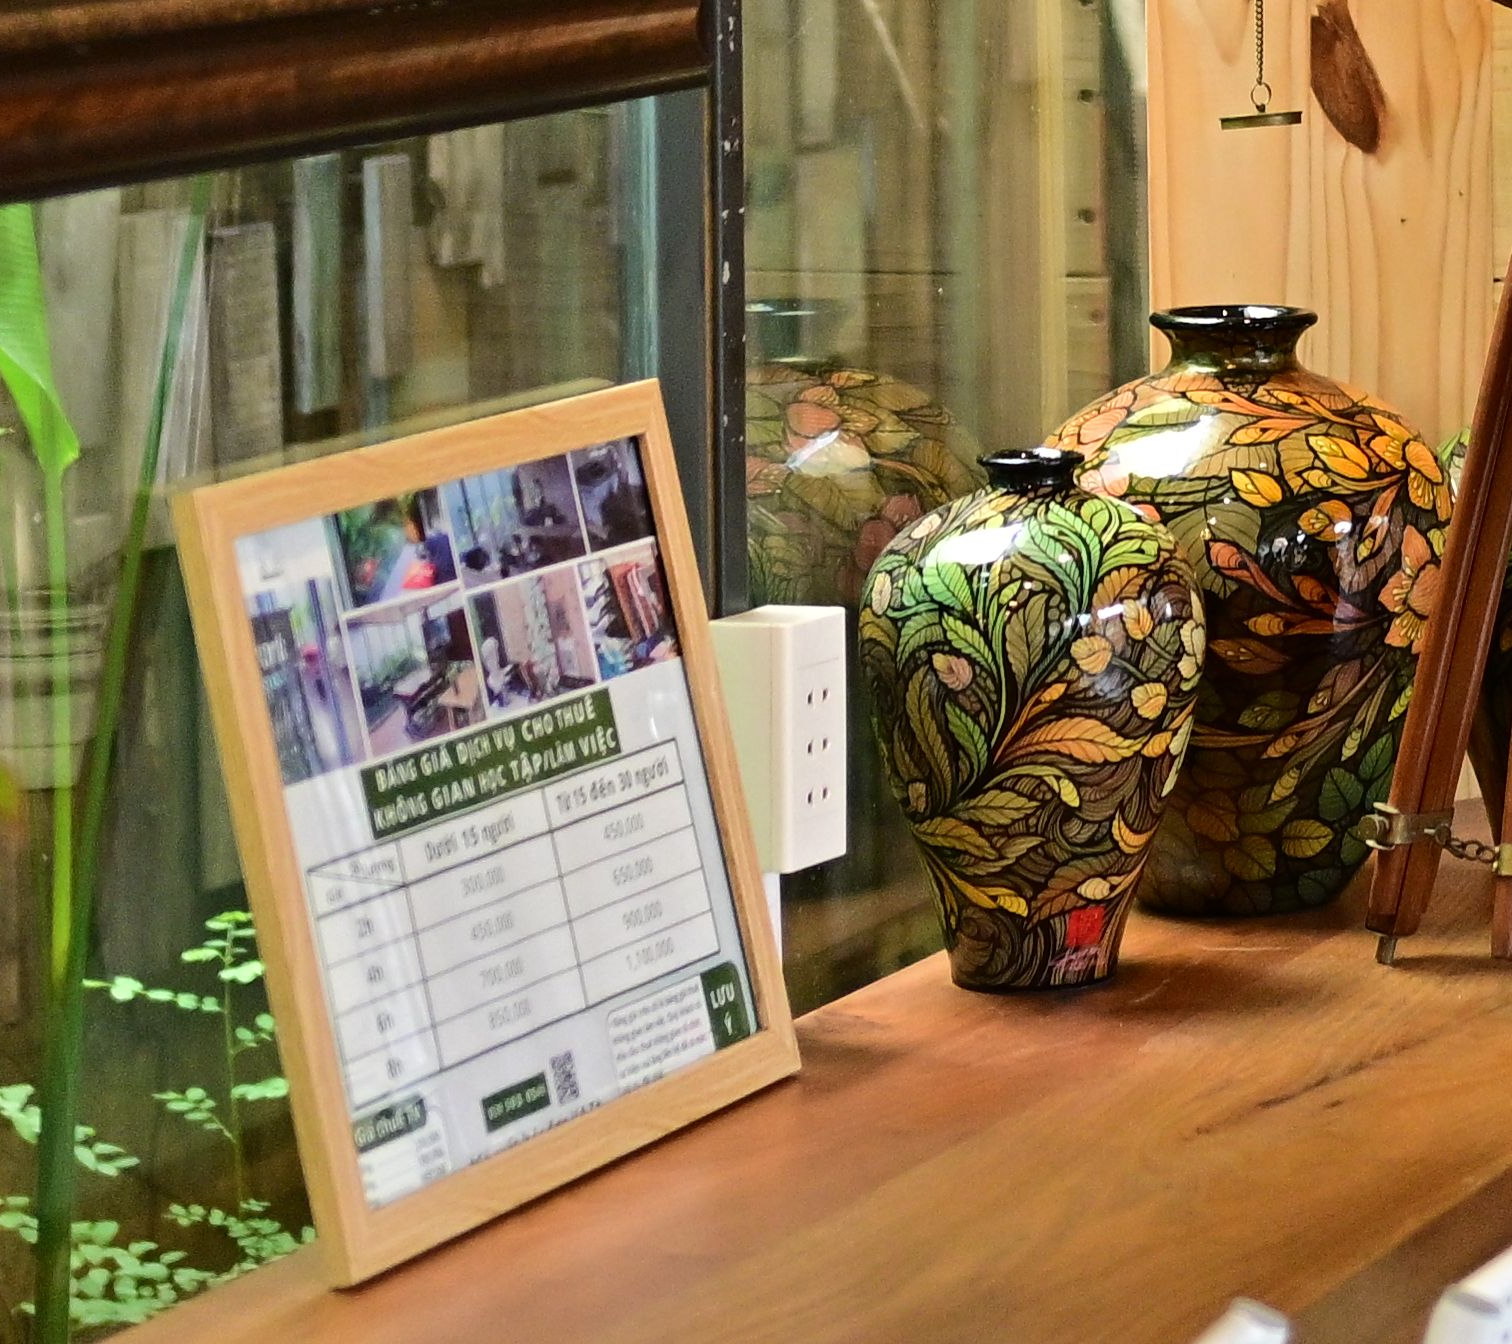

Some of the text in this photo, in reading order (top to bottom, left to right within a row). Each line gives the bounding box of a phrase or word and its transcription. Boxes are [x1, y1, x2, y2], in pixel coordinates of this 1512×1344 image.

[492, 725, 517, 752] VỤ
[521, 713, 554, 743] CHO
[554, 694, 597, 732] THUÊ
[373, 790, 429, 832] KHÔNG
[431, 776, 476, 811] GIAN
[578, 725, 618, 758] VIỆC
[709, 981, 736, 1010] LƯU
